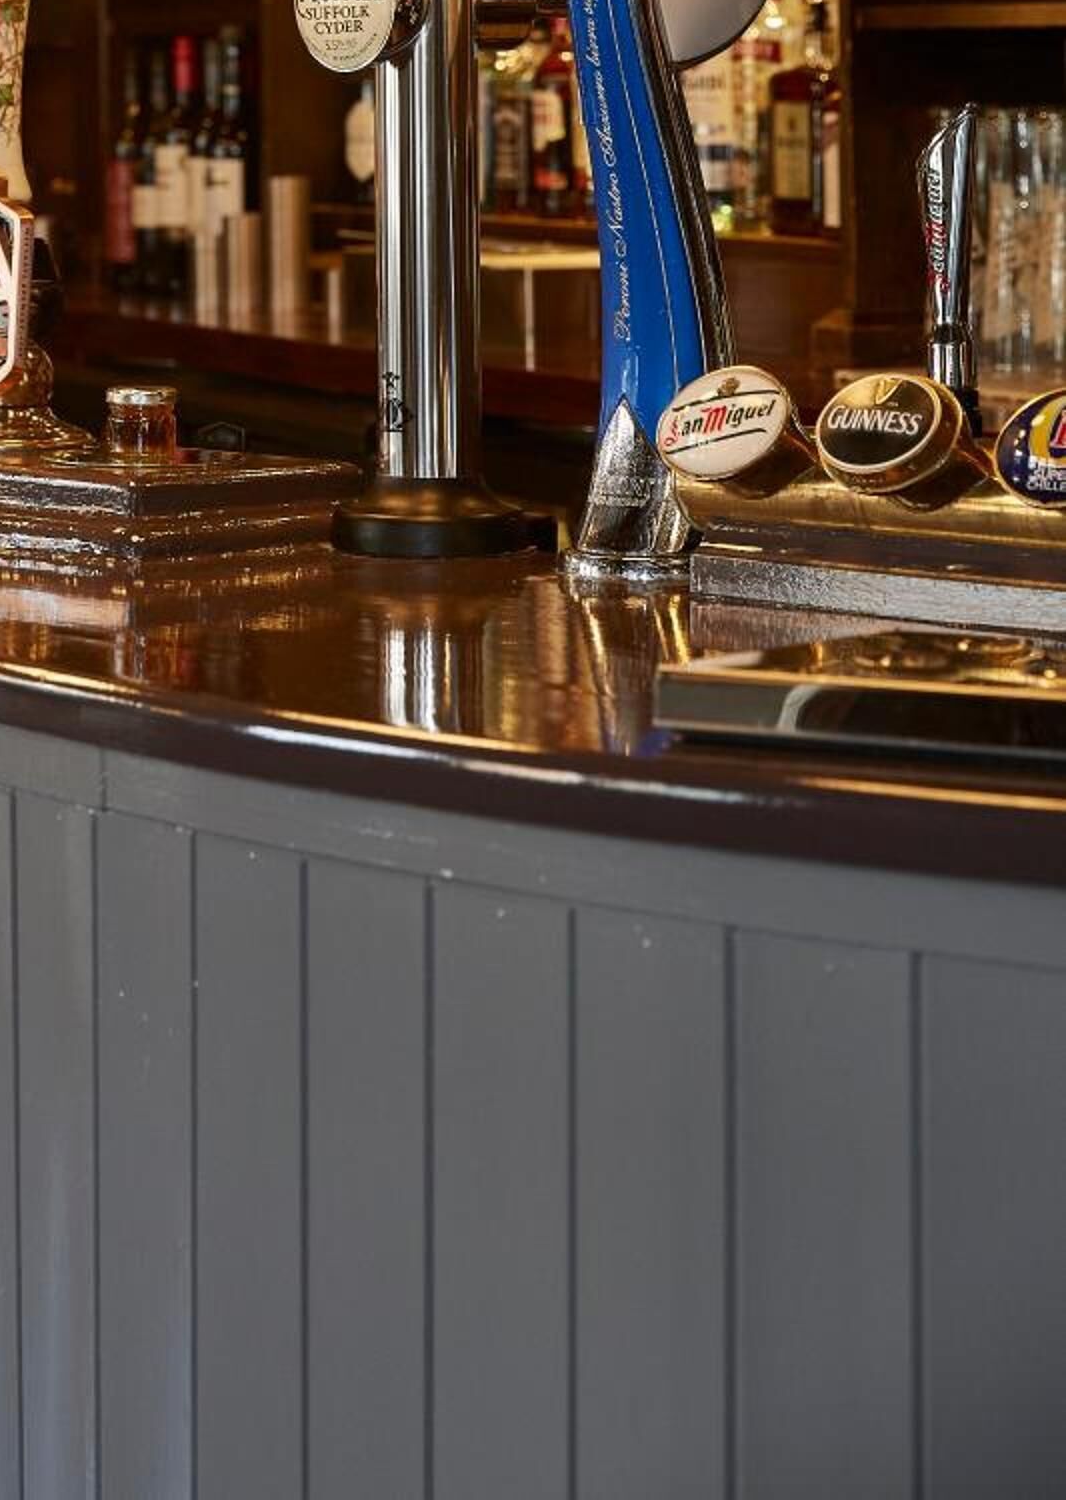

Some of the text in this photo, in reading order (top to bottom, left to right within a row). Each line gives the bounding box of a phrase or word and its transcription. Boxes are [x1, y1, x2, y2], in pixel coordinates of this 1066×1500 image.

[305, 4, 370, 21] SUFFOLK
[313, 19, 365, 35] CYDER
[607, 173, 627, 258] Nastro
[701, 398, 777, 434] Miguel
[827, 404, 923, 436] GUINNESS
